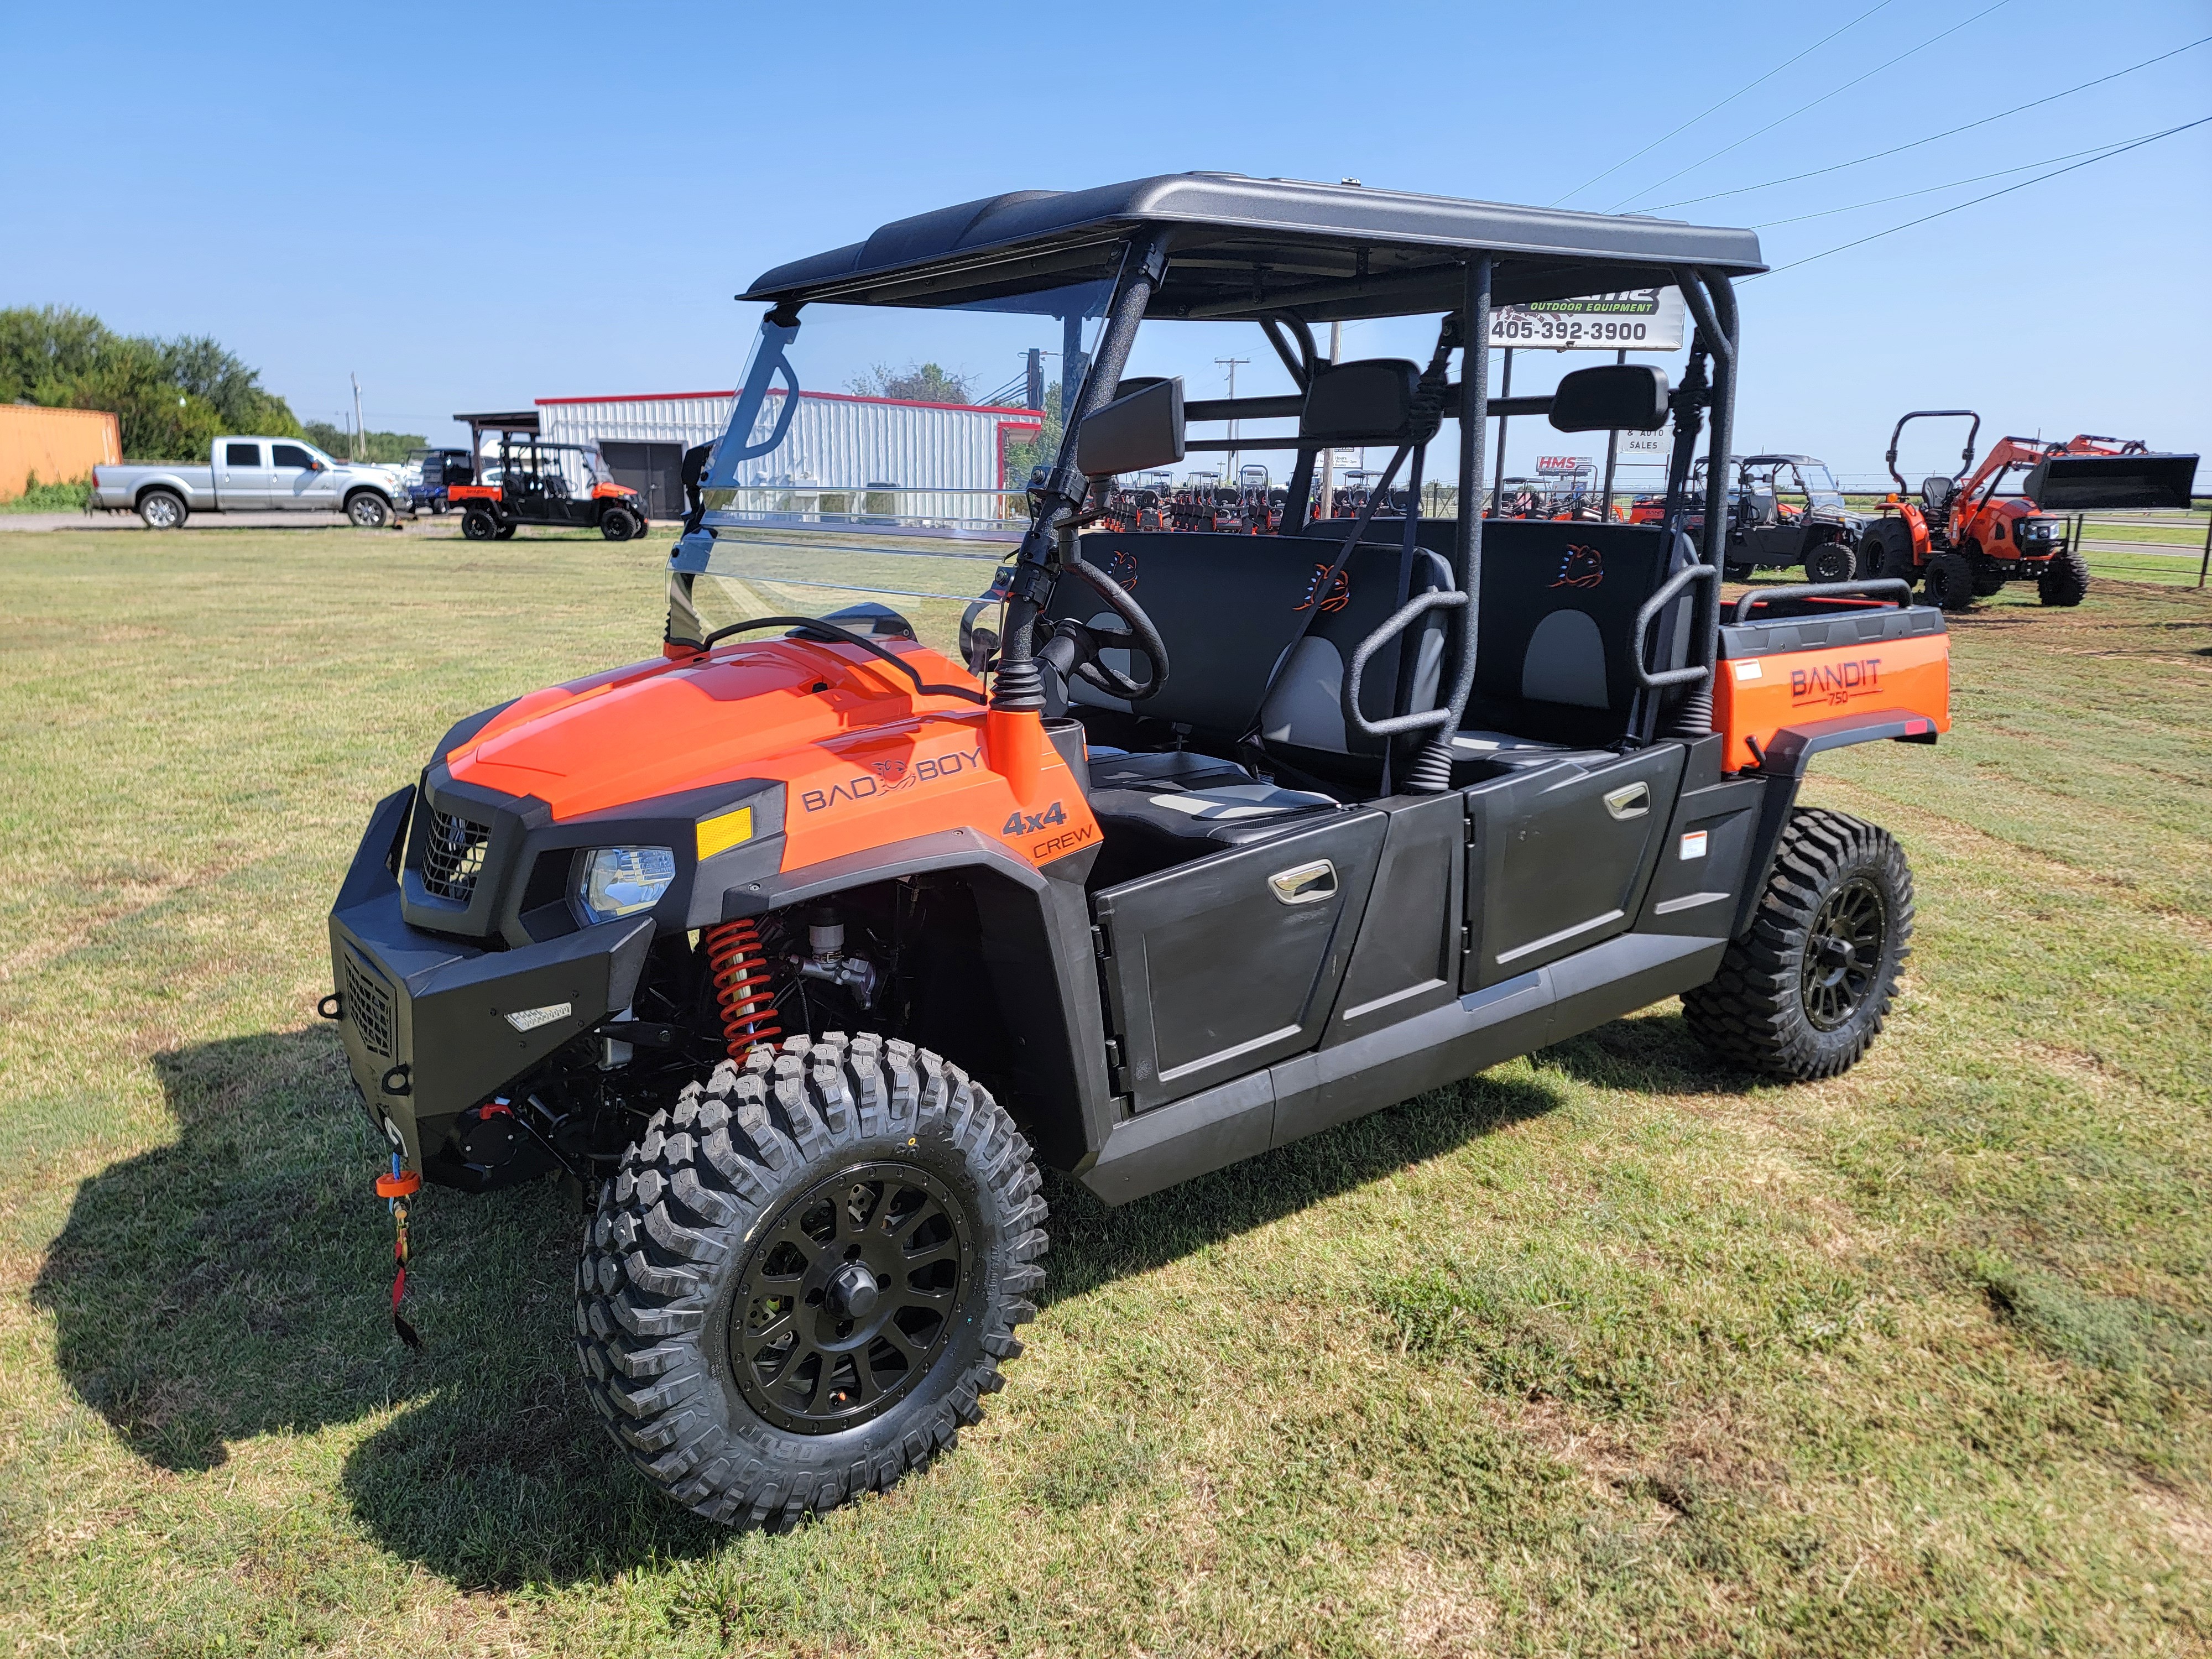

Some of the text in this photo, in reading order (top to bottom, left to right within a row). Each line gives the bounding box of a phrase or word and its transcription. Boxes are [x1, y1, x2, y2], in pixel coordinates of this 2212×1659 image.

[1530, 302, 1652, 312] OUTDOOR EQUIPMENT
[1492, 321, 1646, 340] 405-392-3900
[1539, 457, 1576, 468] HMS
[1792, 659, 1881, 697] BANDIT
[1828, 691, 1848, 706] 750
[802, 747, 981, 812] BAD BOY
[1002, 801, 1067, 836] 4x4
[1033, 824, 1093, 859] CREW
